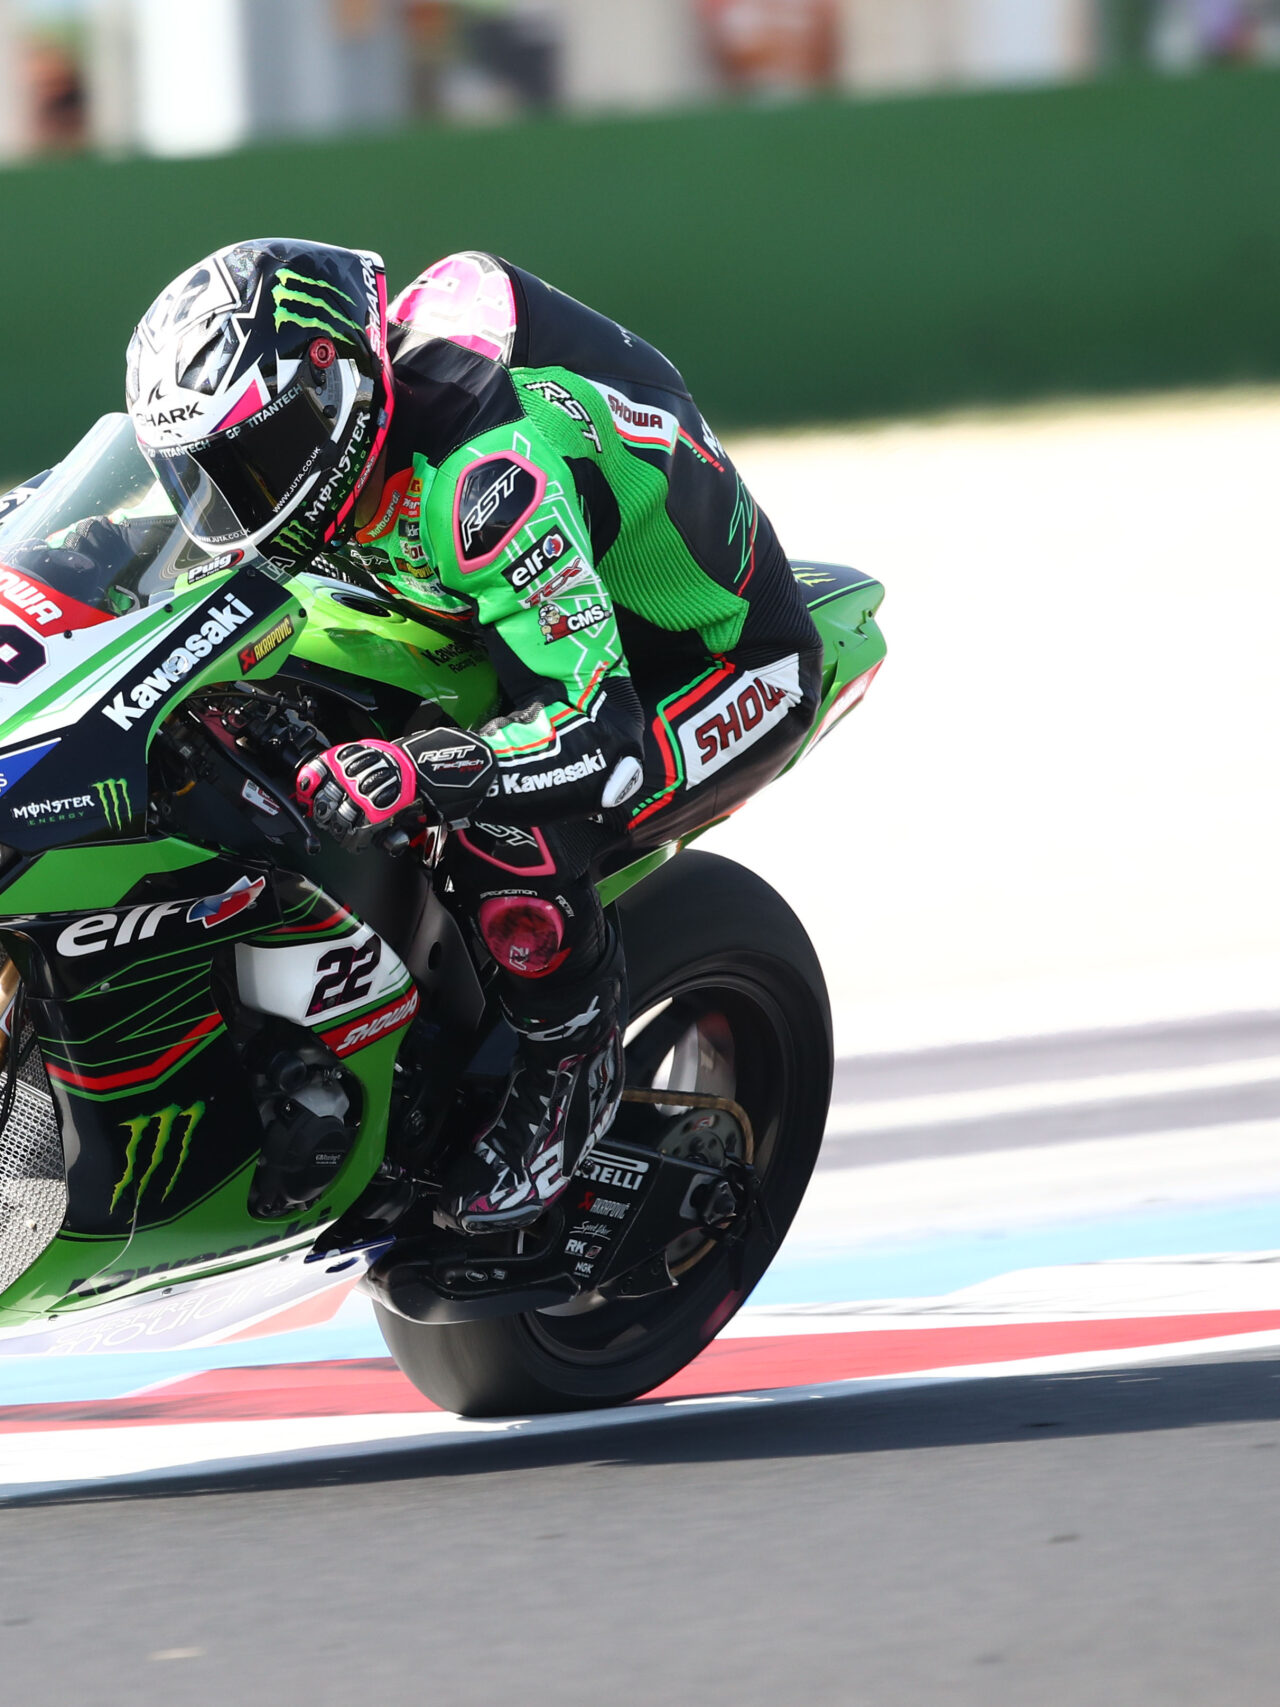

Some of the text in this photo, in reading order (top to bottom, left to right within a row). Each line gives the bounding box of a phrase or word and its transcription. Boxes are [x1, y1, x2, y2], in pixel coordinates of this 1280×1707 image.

[225, 383, 303, 440] GP TITANTECH
[524, 381, 602, 453] RST
[608, 394, 663, 429] SHOWA
[272, 446, 321, 514] WWW.JUTA.CO.UK
[304, 411, 370, 522] MONSTER
[331, 435, 371, 511] ENERGY
[461, 466, 521, 551] RST
[189, 553, 232, 580] Puig
[511, 548, 545, 587] elf
[525, 558, 583, 607] TCX
[567, 604, 605, 631] CMS
[102, 592, 254, 731] Kawasaki
[695, 677, 788, 765] SHOW
[418, 745, 476, 764] RST
[502, 749, 607, 794] Kawasaki
[13, 795, 95, 819] MONSTER
[28, 811, 85, 826] ENERGY
[56, 897, 200, 957] elf
[305, 933, 382, 1018] 22
[336, 994, 419, 1051] SHOWA
[565, 1238, 588, 1254] RK
[575, 1262, 595, 1274] NGK
